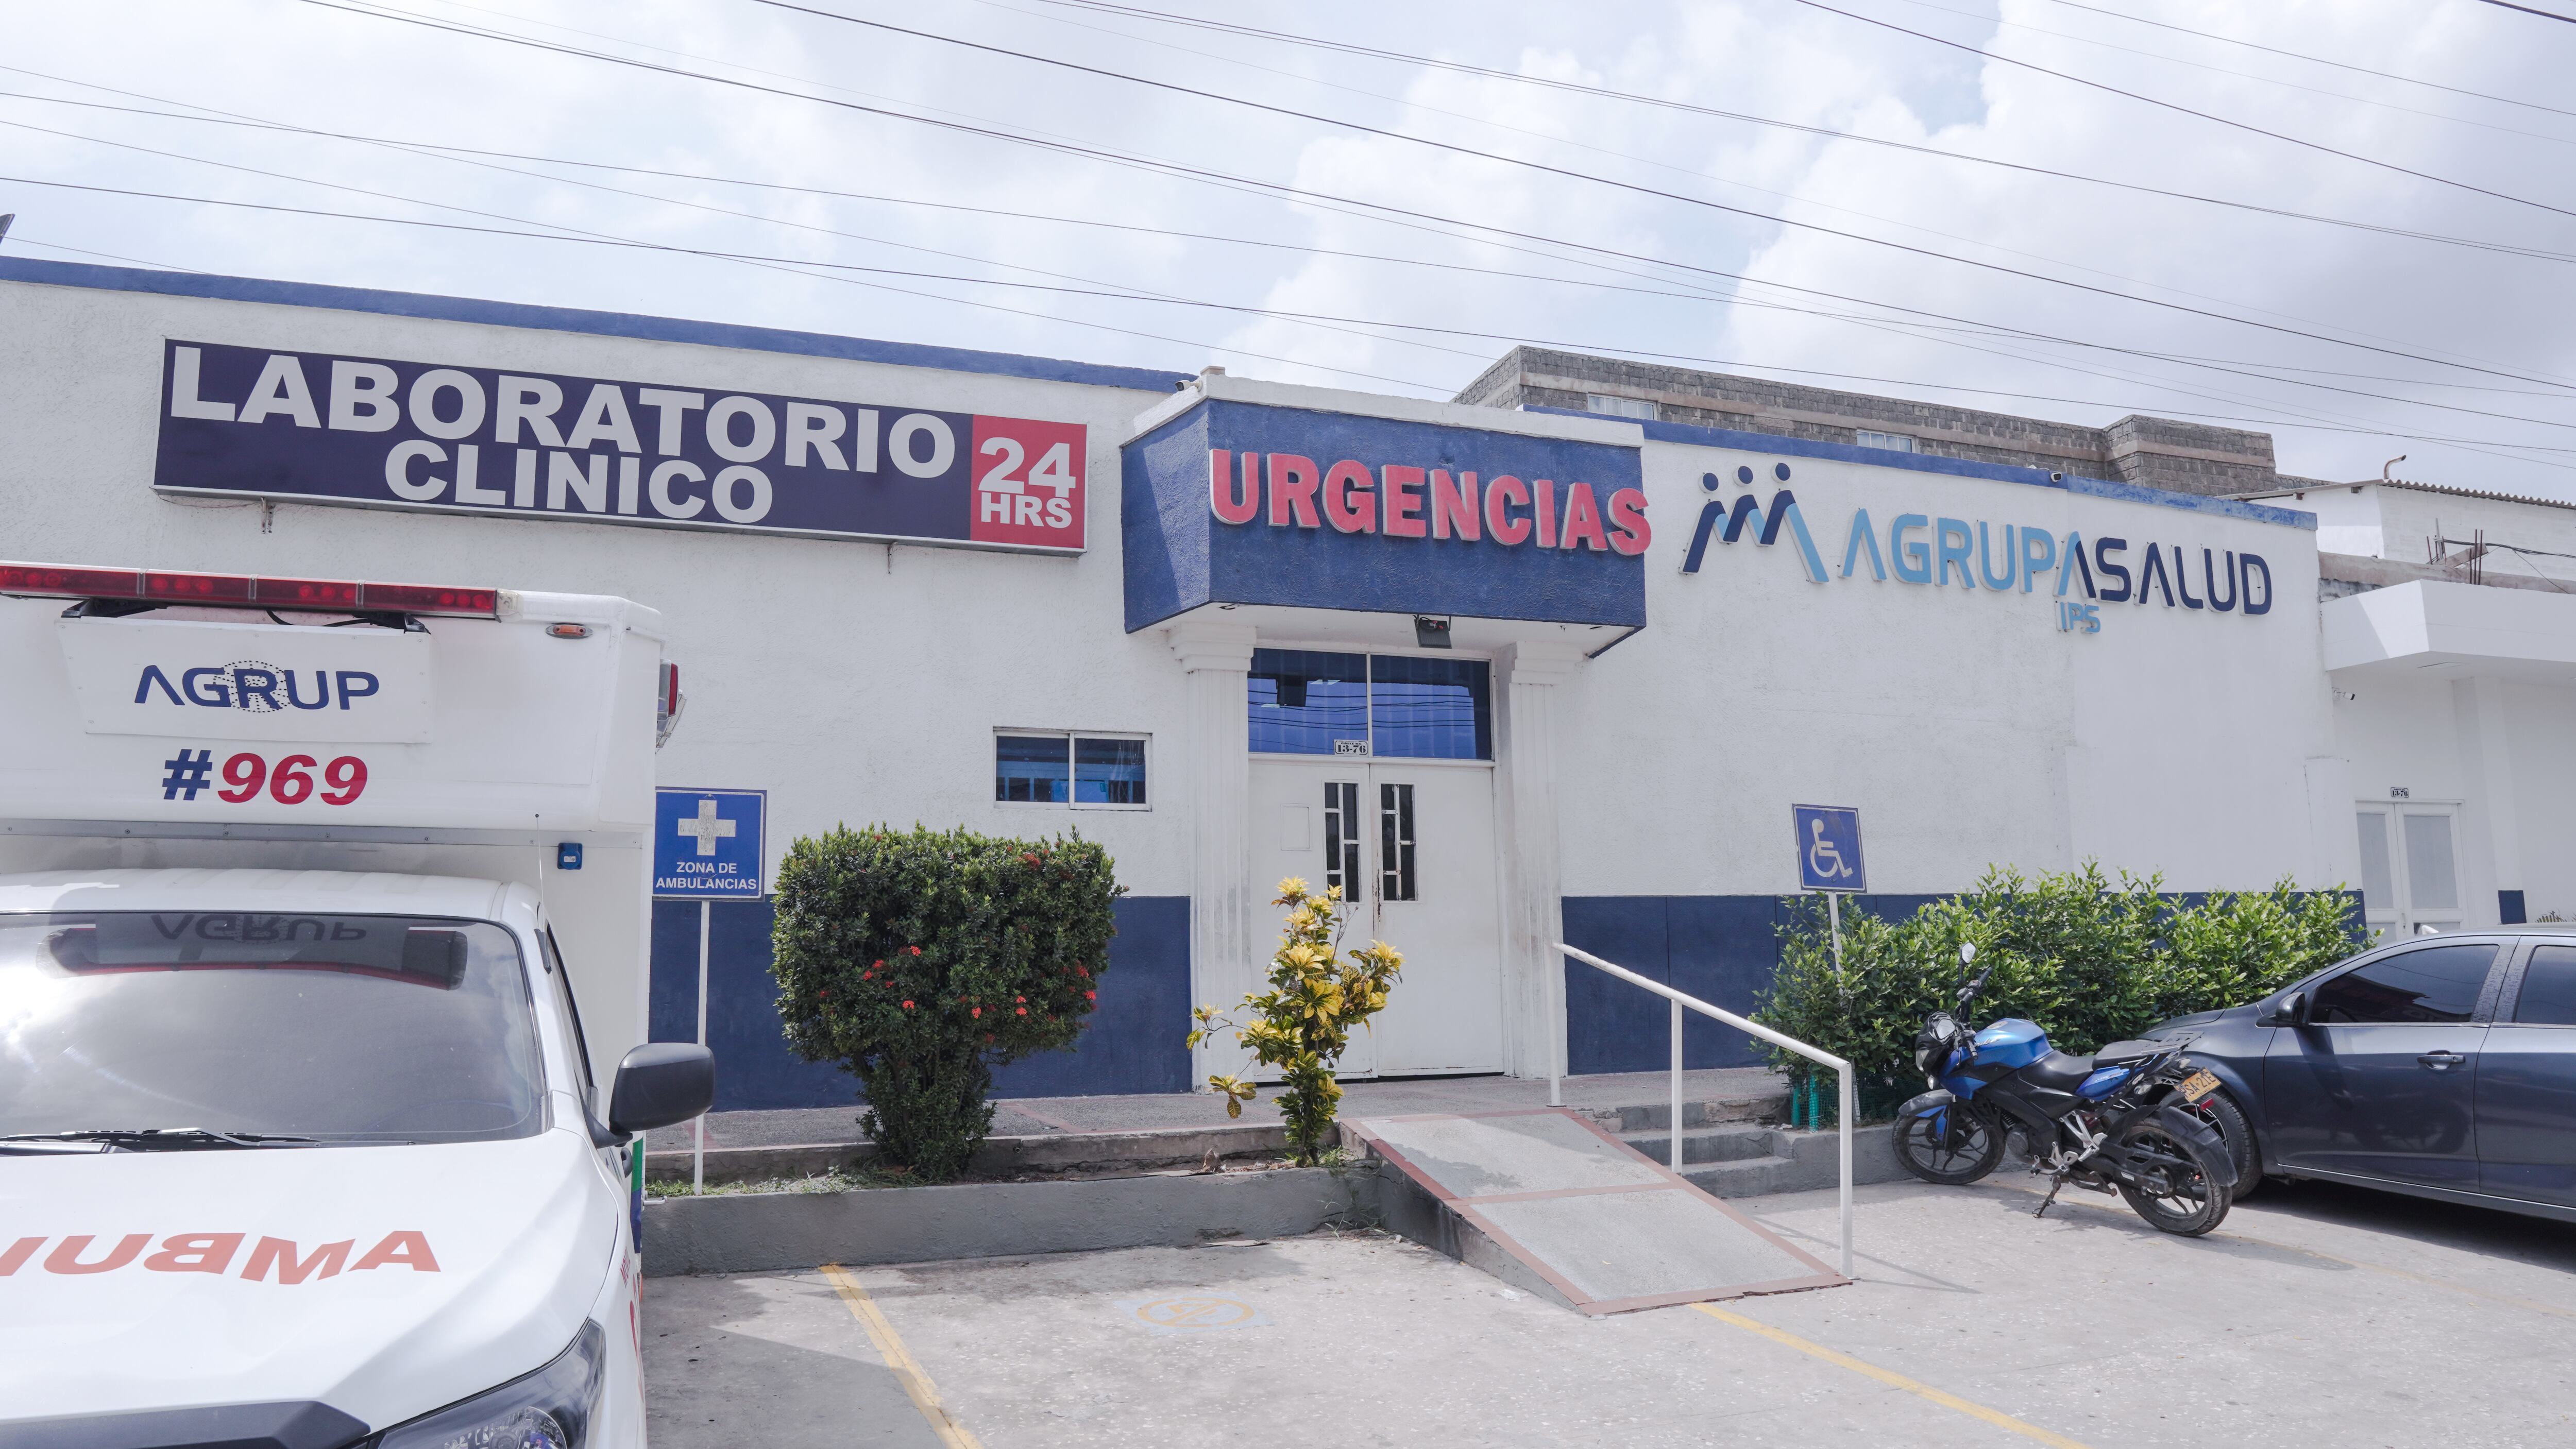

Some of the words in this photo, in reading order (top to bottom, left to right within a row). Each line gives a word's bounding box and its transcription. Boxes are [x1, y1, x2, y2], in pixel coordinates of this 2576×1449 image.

[171, 346, 955, 479] LABORATORIO
[385, 439, 773, 523] CLINICO
[978, 437, 1076, 498] 24
[980, 492, 1072, 529] HRS
[1209, 449, 1651, 556] URGENCIAS
[1838, 507, 2273, 616] AGRUPASALUD
[2056, 601, 2100, 633] IPS
[134, 665, 379, 710] AGRUP
[1338, 745, 1366, 753] 13-76
[162, 749, 368, 806] #969
[656, 877, 757, 890] AMBULANCIAS
[676, 862, 715, 873] ZONA
[719, 863, 737, 874] DE
